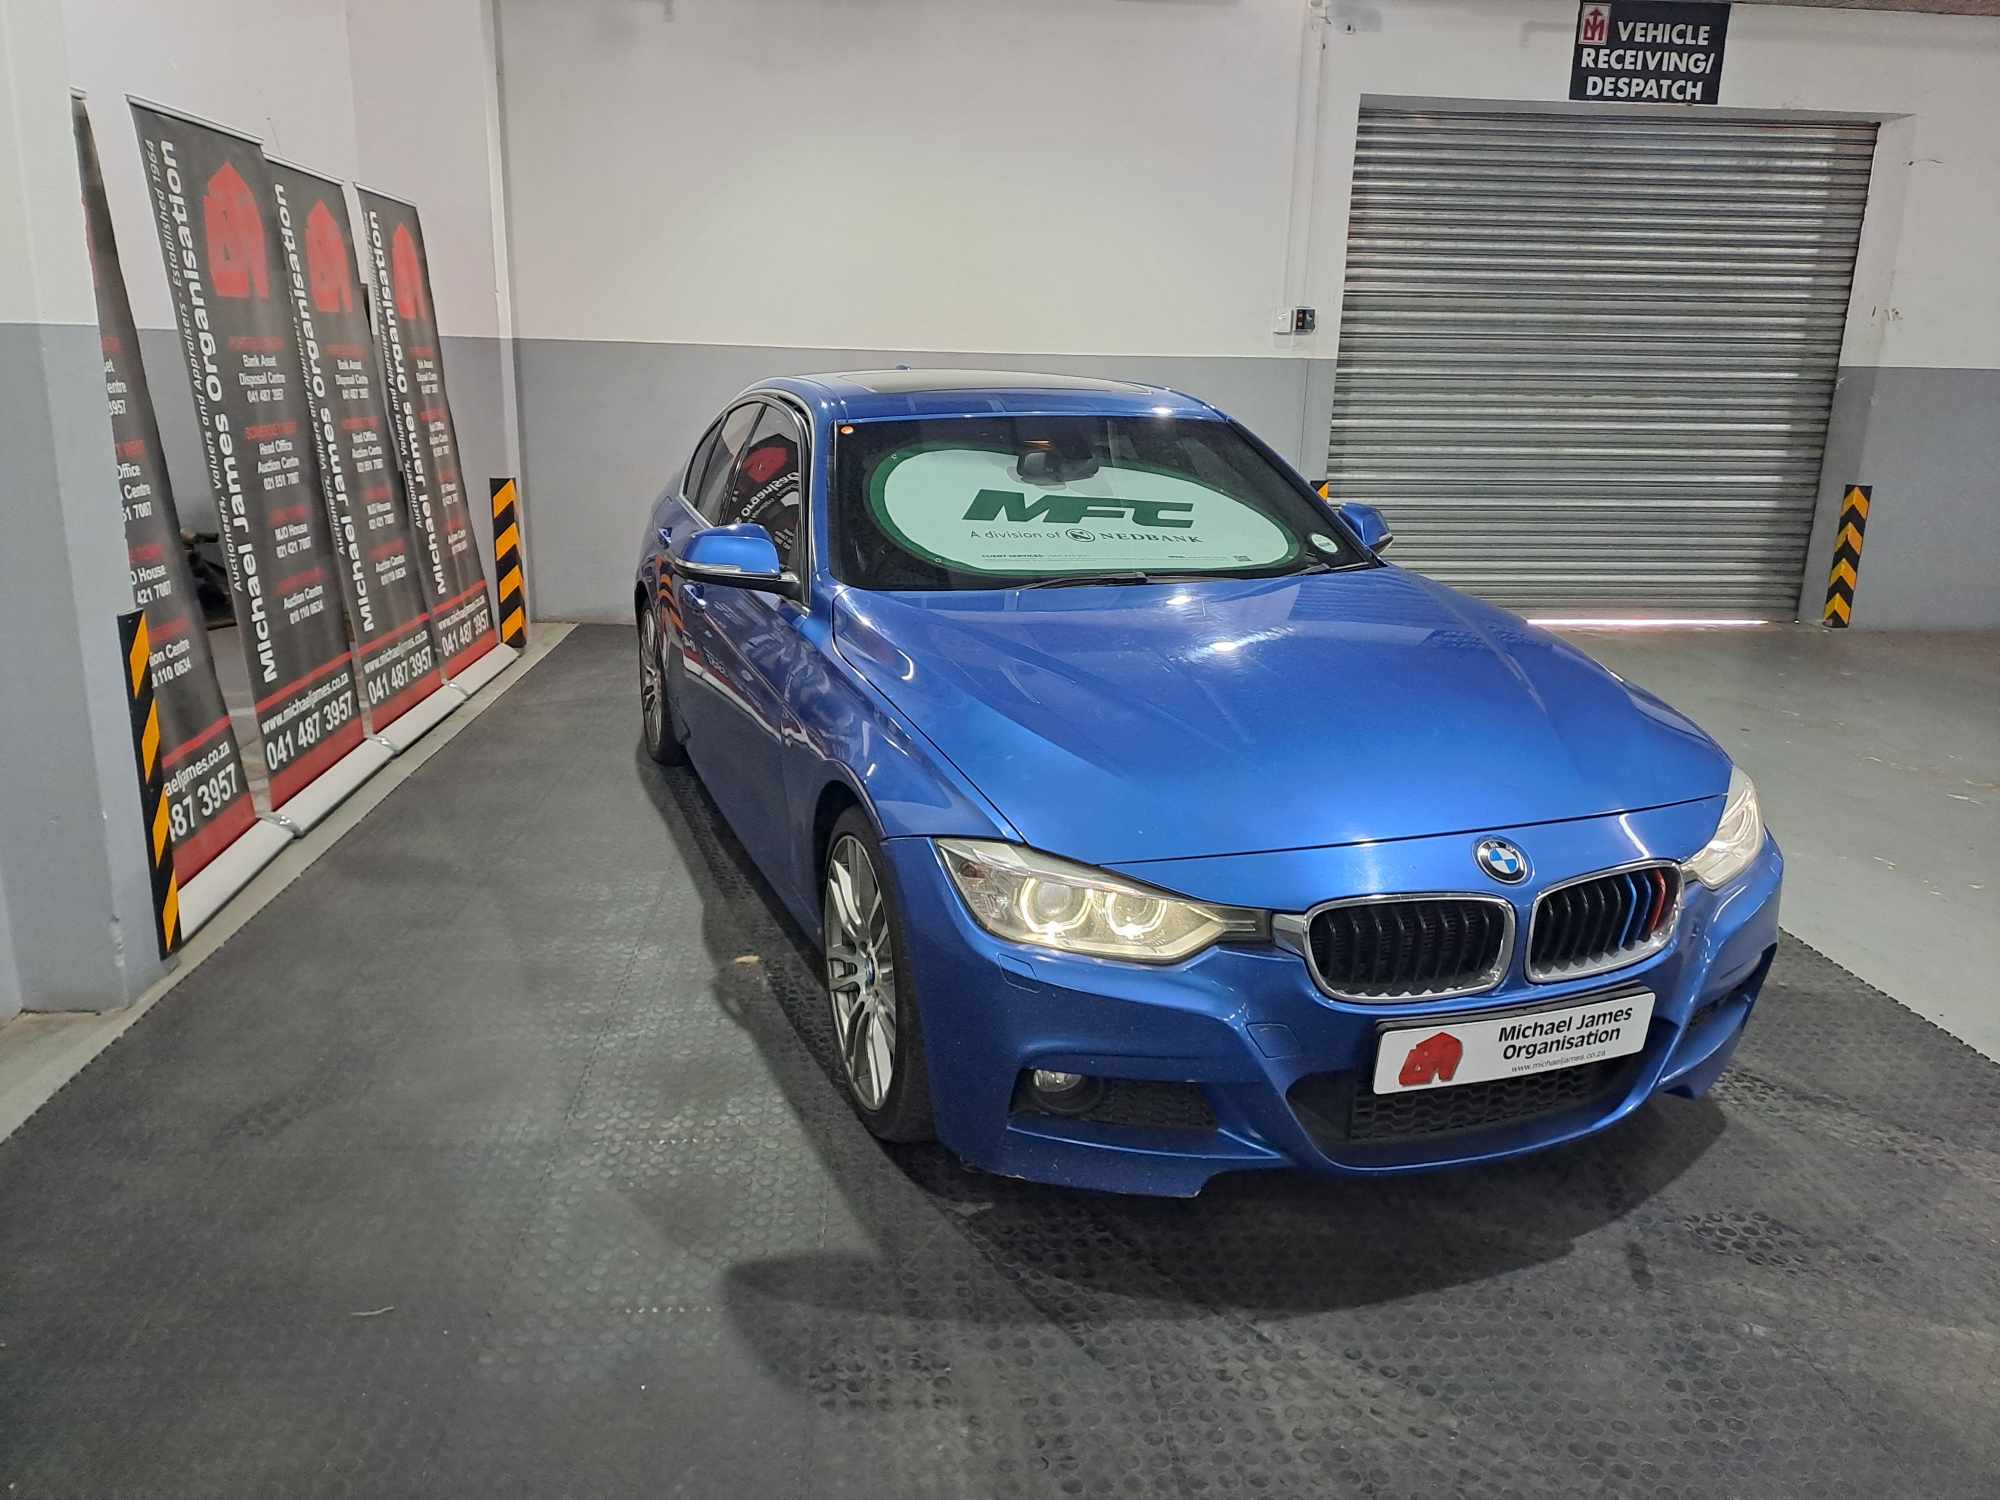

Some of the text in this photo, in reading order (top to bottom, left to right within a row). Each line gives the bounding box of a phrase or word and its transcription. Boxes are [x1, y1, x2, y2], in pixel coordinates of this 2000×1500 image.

[1581, 47, 1716, 74] RECEIVING/
[1617, 21, 1711, 46] VEHICLE
[1585, 75, 1703, 101] DESPATCH
[153, 187, 183, 288] Established
[274, 183, 326, 398] Organisation
[369, 210, 408, 394] Organisation
[179, 303, 203, 390] Appraisers
[160, 139, 278, 683] Michael James Organisation
[195, 394, 210, 426] and
[320, 407, 349, 507] James
[402, 401, 426, 487] James
[961, 488, 1194, 529] MFC
[969, 528, 1204, 544] A division of NEDBANK
[419, 494, 447, 595] Michael
[139, 564, 167, 583] House
[341, 516, 374, 633] Michael
[441, 629, 460, 657] 041
[459, 620, 473, 645] 487
[367, 645, 432, 705] 041 487 3957
[266, 690, 353, 771] 041 487 3957
[197, 762, 238, 817] 3957
[1498, 1007, 1633, 1042] Michael James
[1503, 1028, 1621, 1060] Organisation
